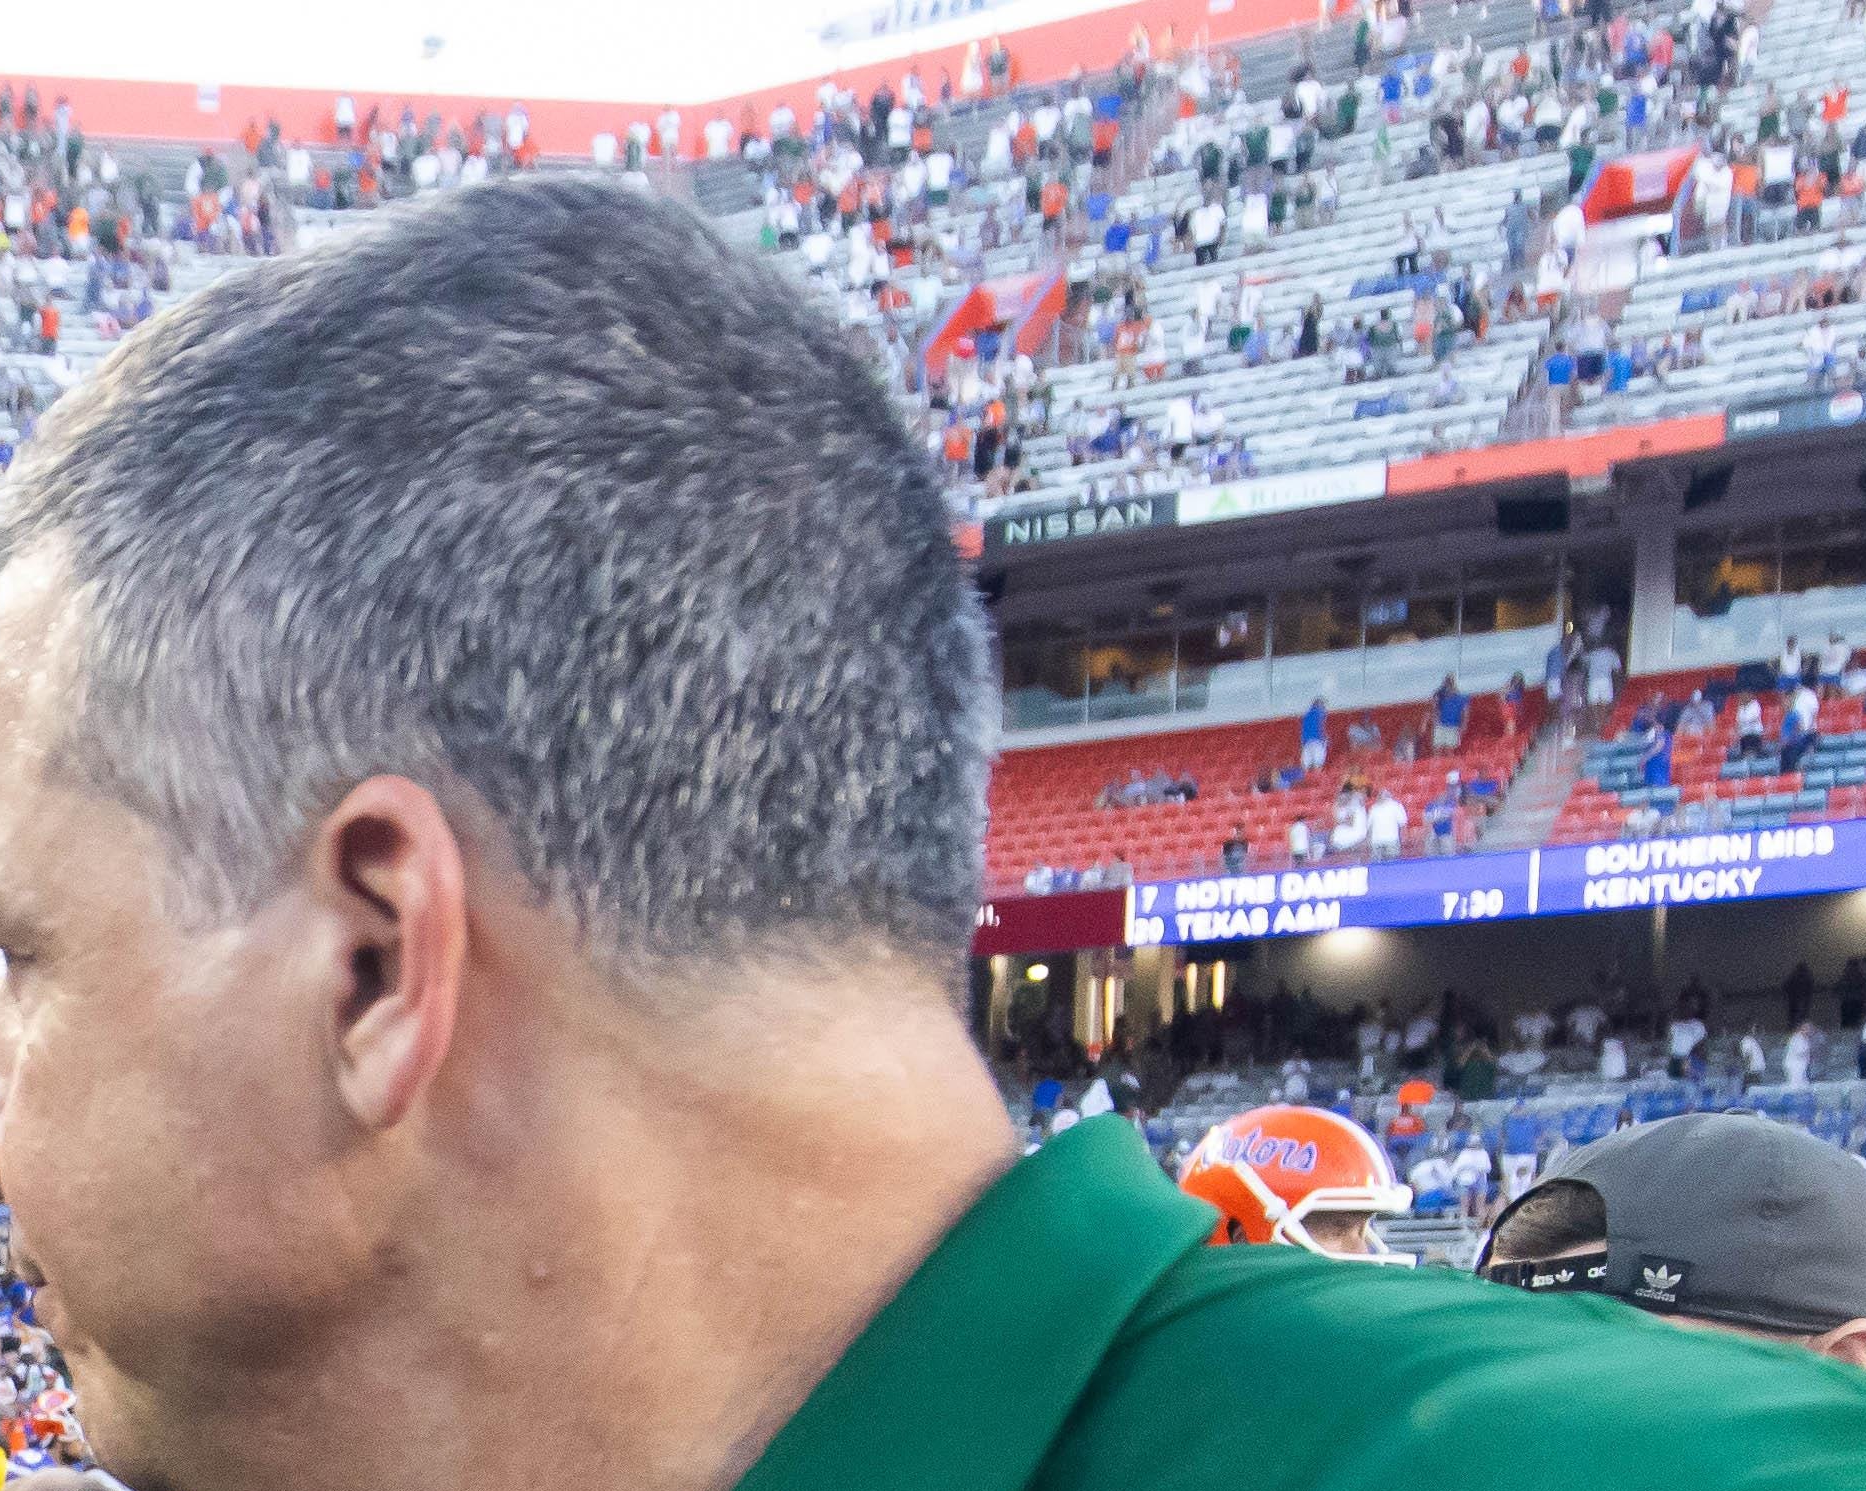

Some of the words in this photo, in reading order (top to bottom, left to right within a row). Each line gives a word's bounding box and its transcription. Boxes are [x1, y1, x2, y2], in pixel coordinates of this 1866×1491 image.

[1003, 499, 1154, 545] NISSAN
[1584, 831, 1753, 876] SOUTHERN
[1757, 825, 1836, 860] MISS
[1141, 885, 1159, 914] 7
[1174, 874, 1276, 912] NOTRE
[1278, 866, 1370, 902] DAME
[1583, 865, 1763, 909] KENTUCKY
[1174, 905, 1270, 943] TEXAS
[1272, 900, 1342, 933] A&M
[1634, 1287, 1677, 1304] adidas
